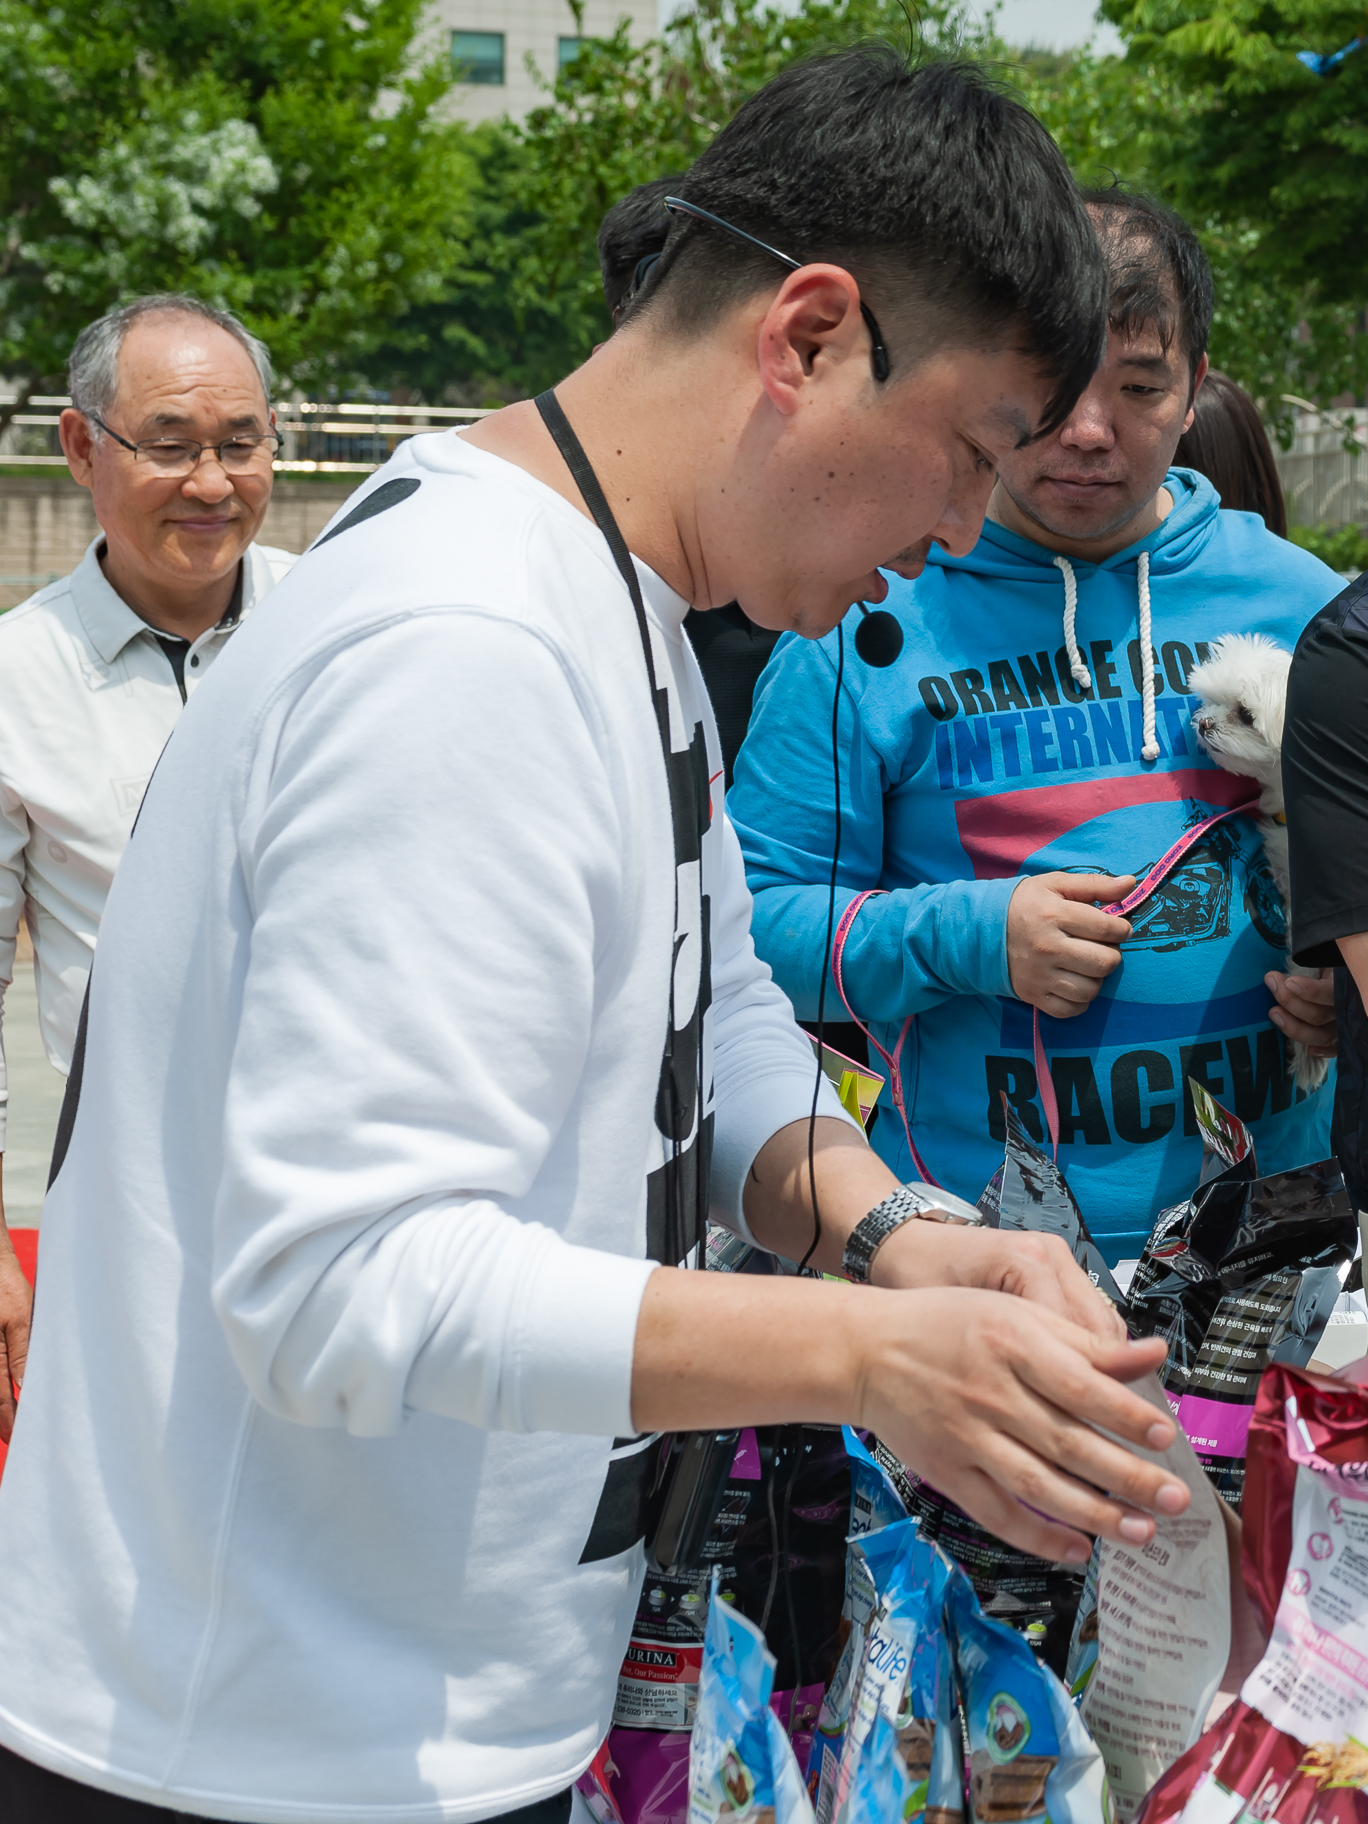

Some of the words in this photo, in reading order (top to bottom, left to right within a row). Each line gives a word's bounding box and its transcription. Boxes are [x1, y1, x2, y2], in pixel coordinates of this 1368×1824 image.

[918, 640, 1122, 721] ORANGE
[1150, 864, 1166, 881] DOG
[985, 1028, 1328, 1146] RACEW
[1221, 1260, 1247, 1276] 에너지를
[628, 1648, 674, 1666] URINA
[634, 1667, 648, 1678] Our
[644, 1686, 679, 1697] 상담하세요
